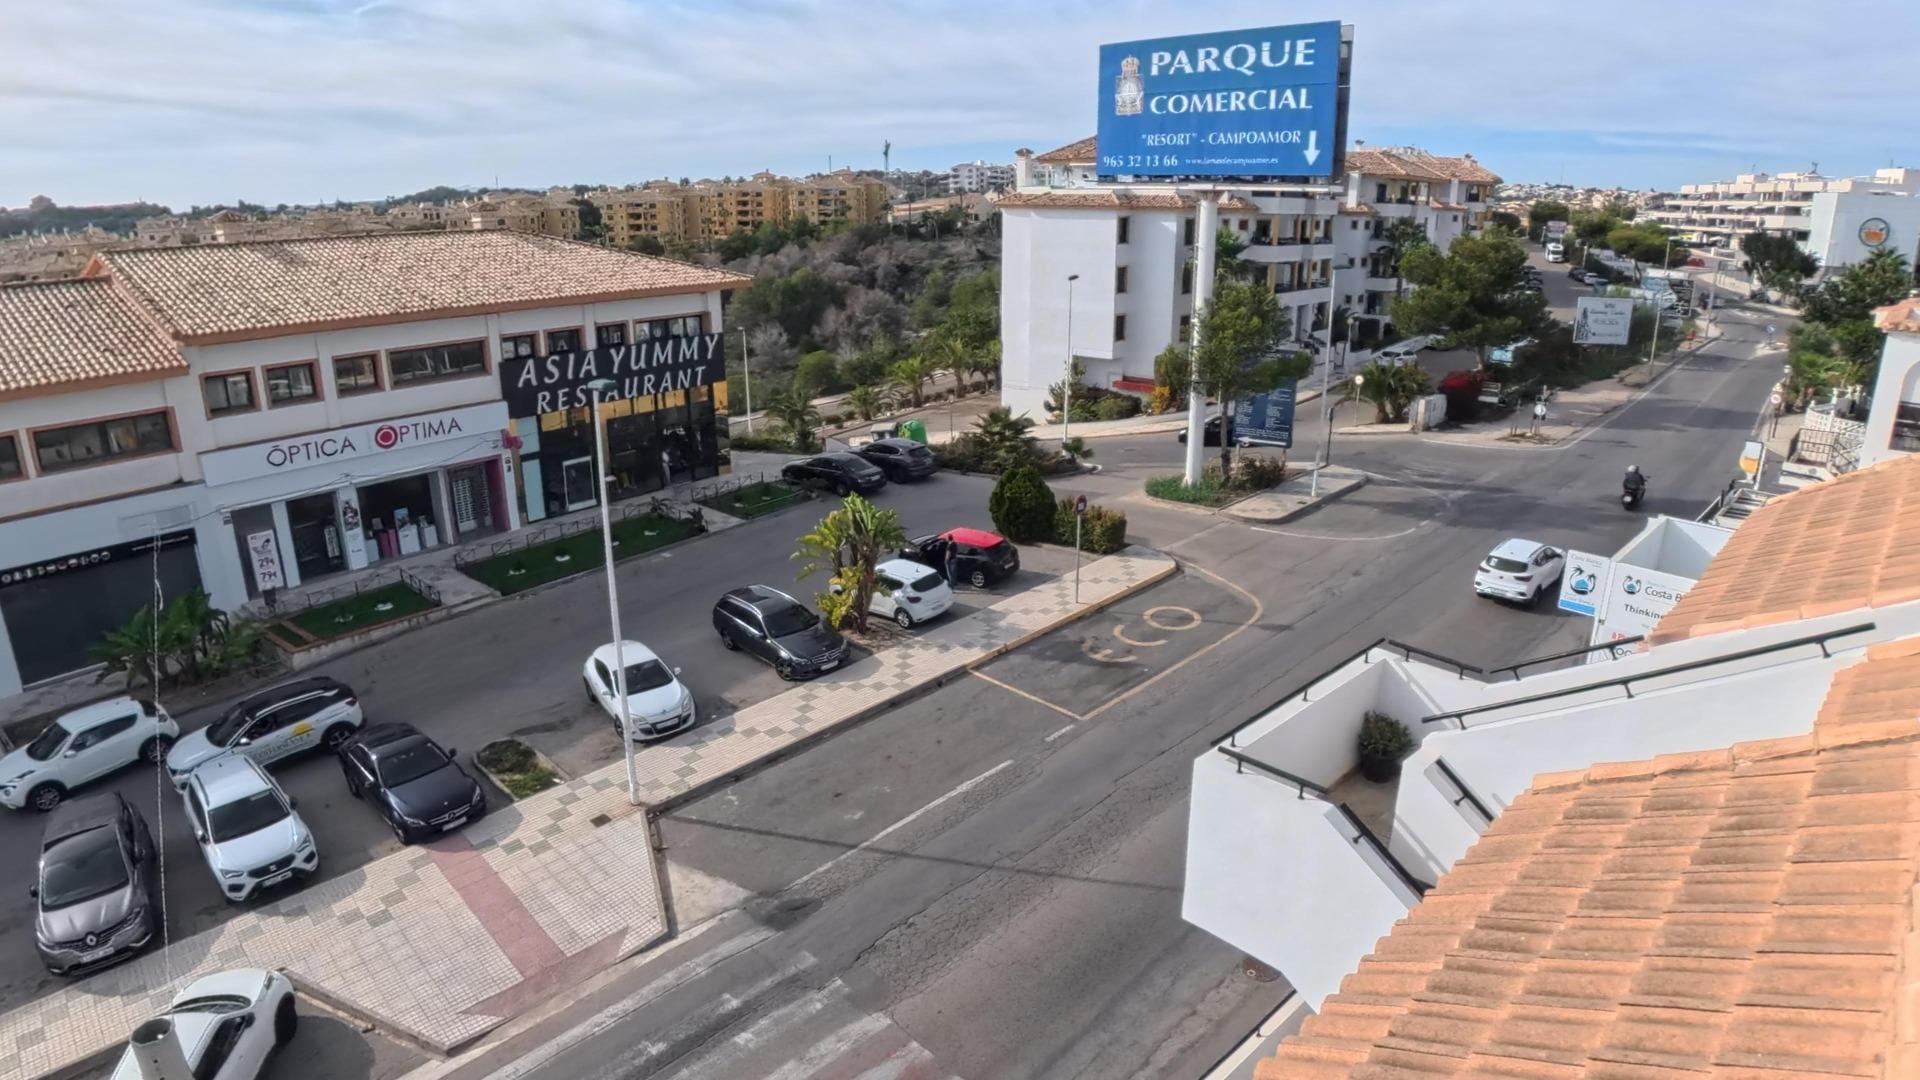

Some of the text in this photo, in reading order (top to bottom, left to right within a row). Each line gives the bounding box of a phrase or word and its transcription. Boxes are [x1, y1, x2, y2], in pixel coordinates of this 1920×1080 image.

[1150, 38, 1316, 77] PARQUE
[1150, 87, 1313, 115] COMERCIAL
[1208, 130, 1301, 145] CAMPOAMOR
[1103, 155, 1123, 168] 965
[1127, 155, 1141, 167] 32
[1146, 155, 1159, 167] 13
[1163, 154, 1178, 167] 66
[517, 334, 719, 388] ASIA YUMMY
[1644, 585, 1673, 601] Costa
